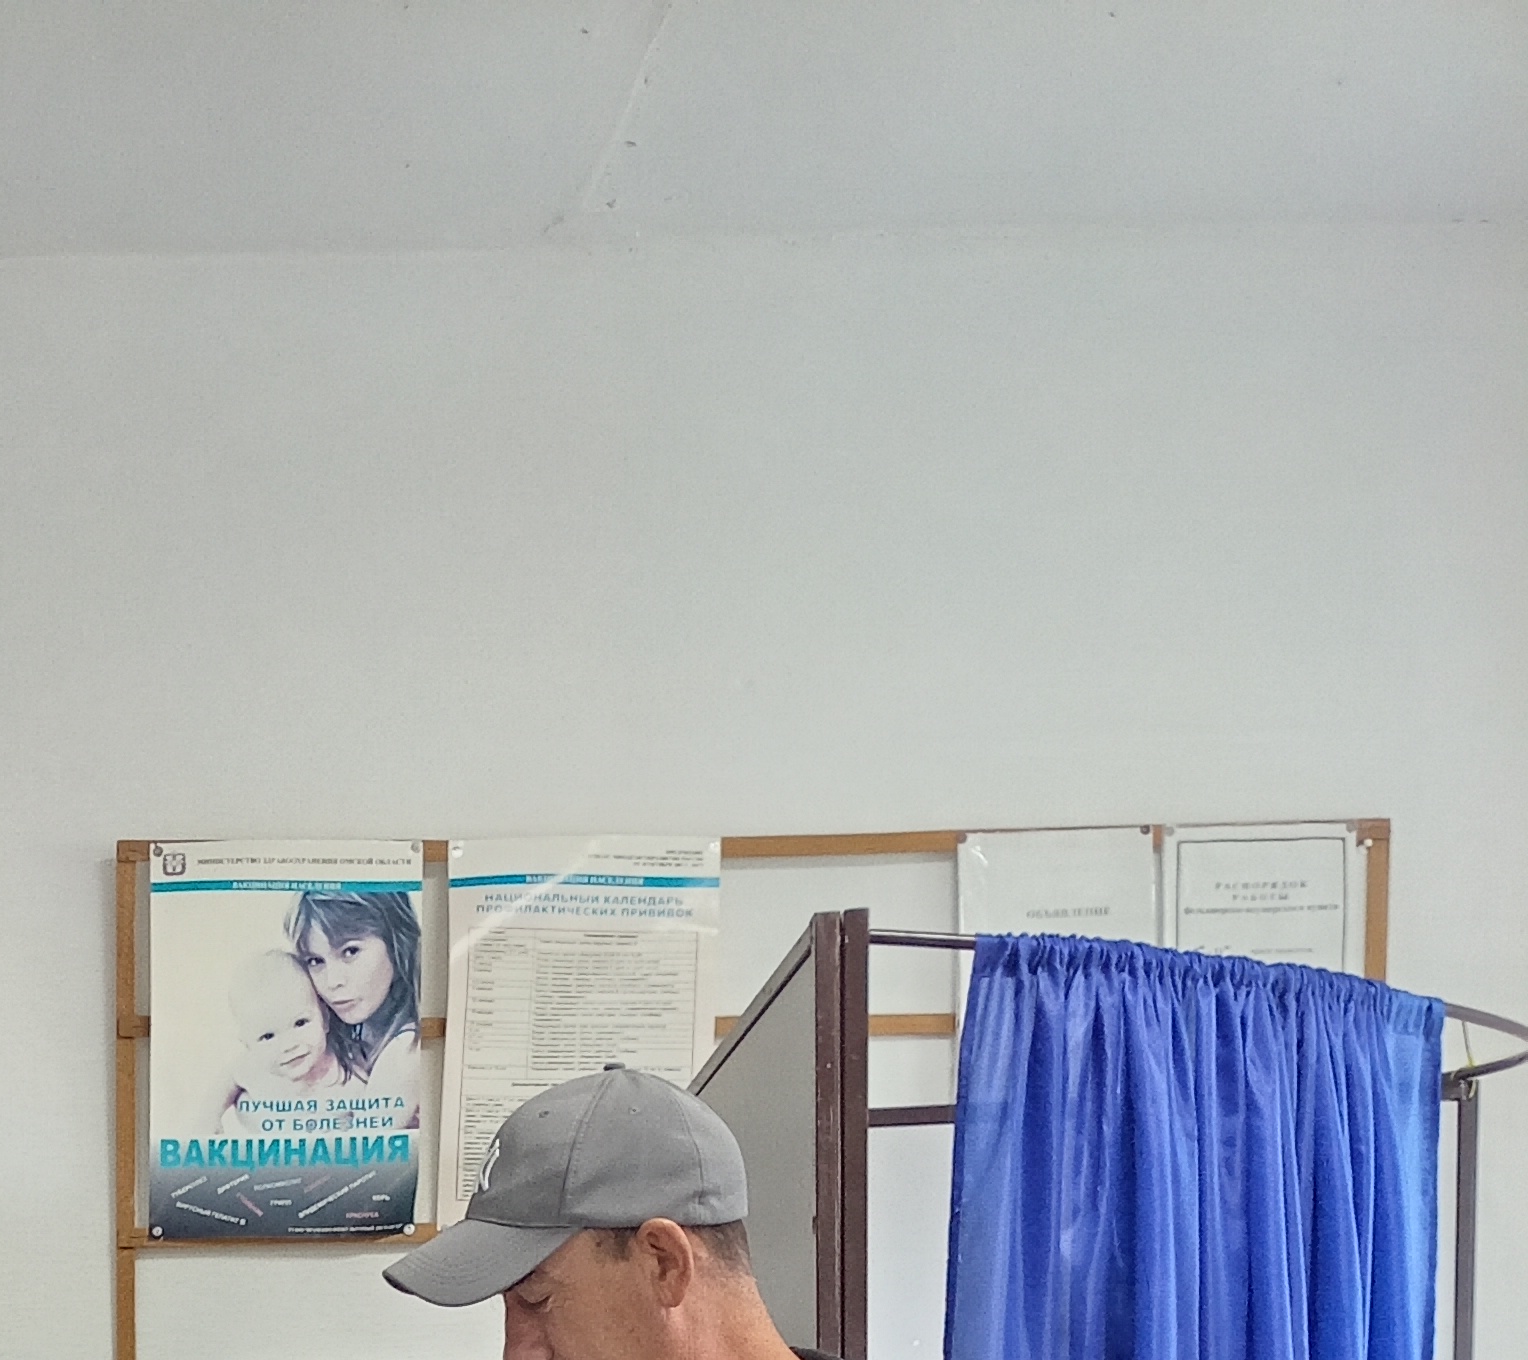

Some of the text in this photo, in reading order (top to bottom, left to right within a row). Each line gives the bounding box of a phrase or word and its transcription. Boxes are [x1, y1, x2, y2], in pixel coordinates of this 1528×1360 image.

[603, 894, 684, 906] КАЛЕНДАРЬ
[475, 904, 694, 918] ПРОИЛАКТИЧЕСКИХ ПРИВИВОК
[326, 1096, 405, 1112] ЗАЩИТА
[261, 1118, 286, 1132] ОТ
[159, 1134, 411, 1171] ВАКЦИНАЦИЯ
